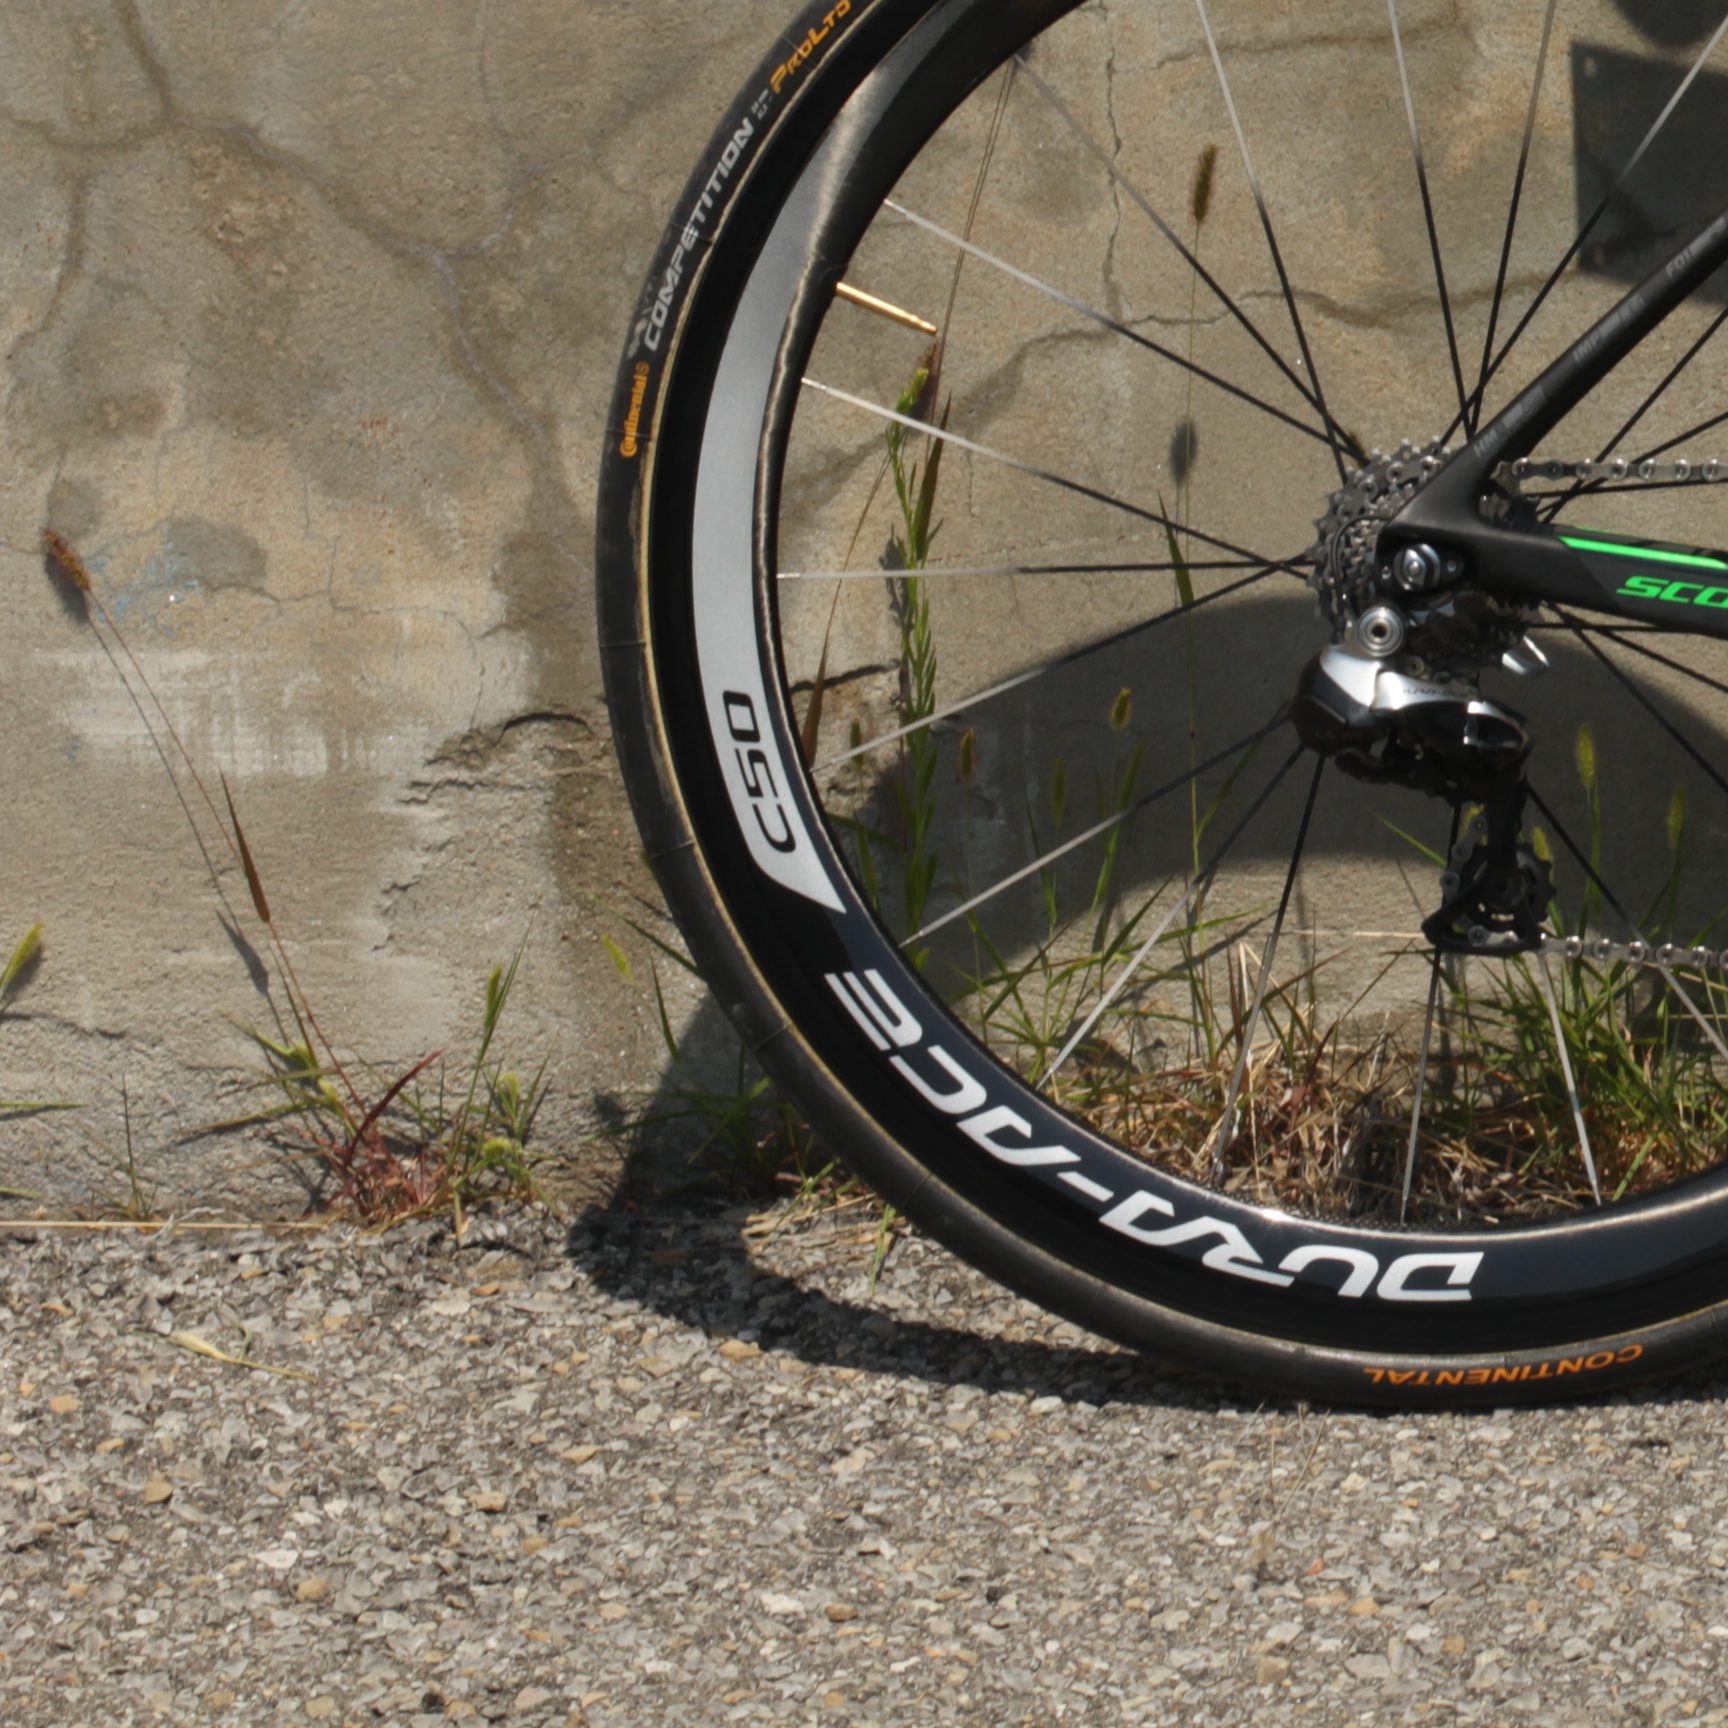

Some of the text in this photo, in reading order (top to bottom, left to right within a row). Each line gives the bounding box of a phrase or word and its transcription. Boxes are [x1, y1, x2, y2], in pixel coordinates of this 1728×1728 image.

[644, 117, 754, 352] COMPETITION
[723, 690, 796, 853] C50
[825, 968, 1484, 1302] DURA-ACE
[1363, 1344, 1644, 1385] CONTINENTAL
